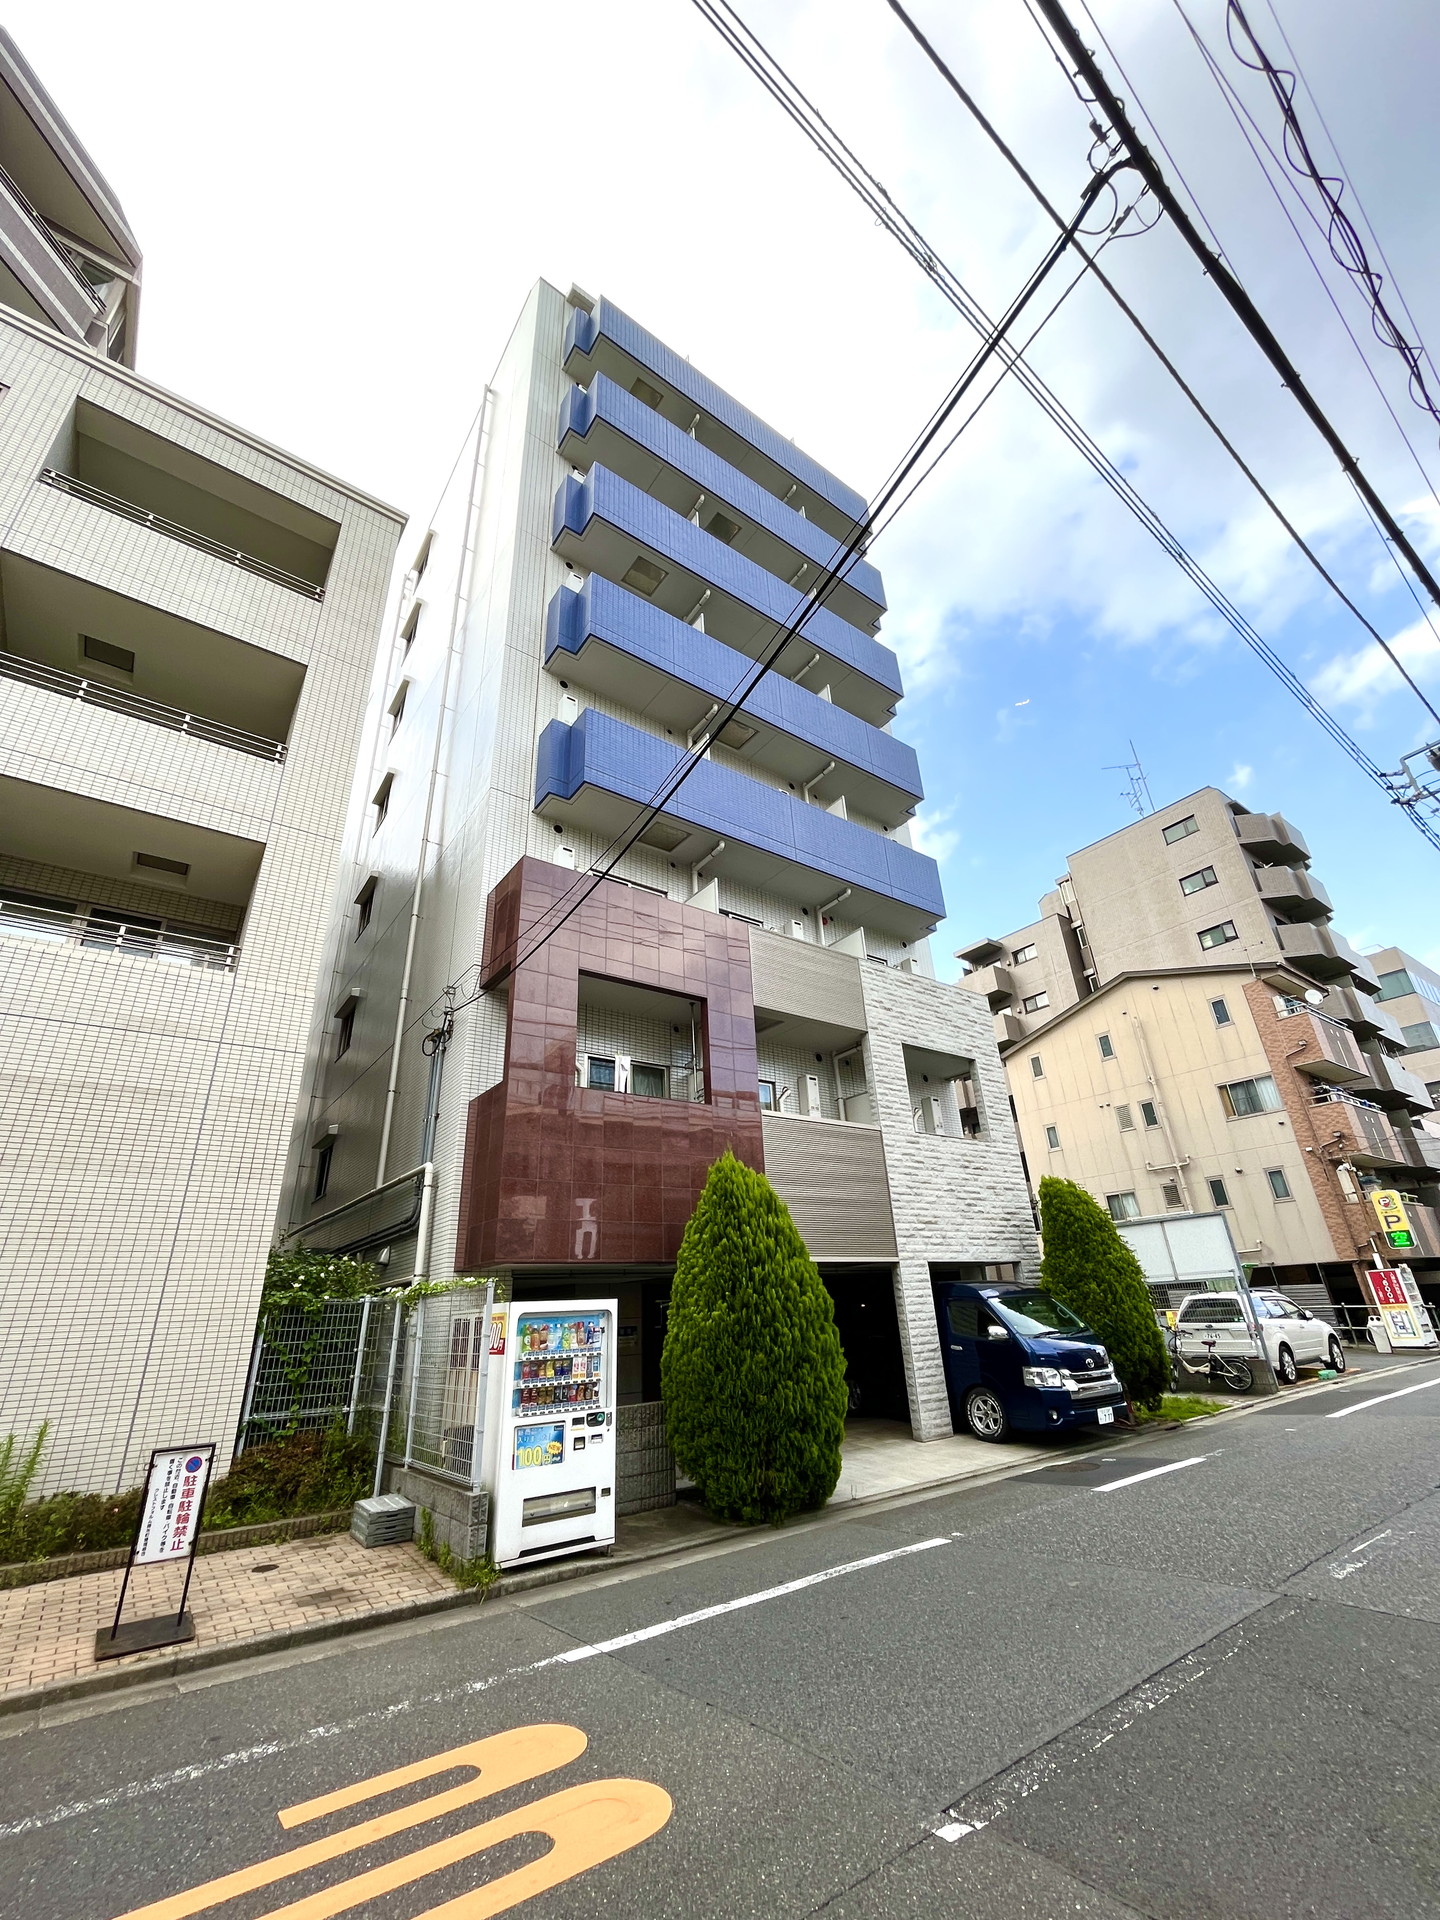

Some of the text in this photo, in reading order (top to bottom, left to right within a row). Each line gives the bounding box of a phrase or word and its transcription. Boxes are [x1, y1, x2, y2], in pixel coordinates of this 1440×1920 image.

[1384, 1215, 1401, 1229] P
[1391, 1232, 1410, 1245] 空
[170, 1475, 198, 1551] 駐車駐輪禁止
